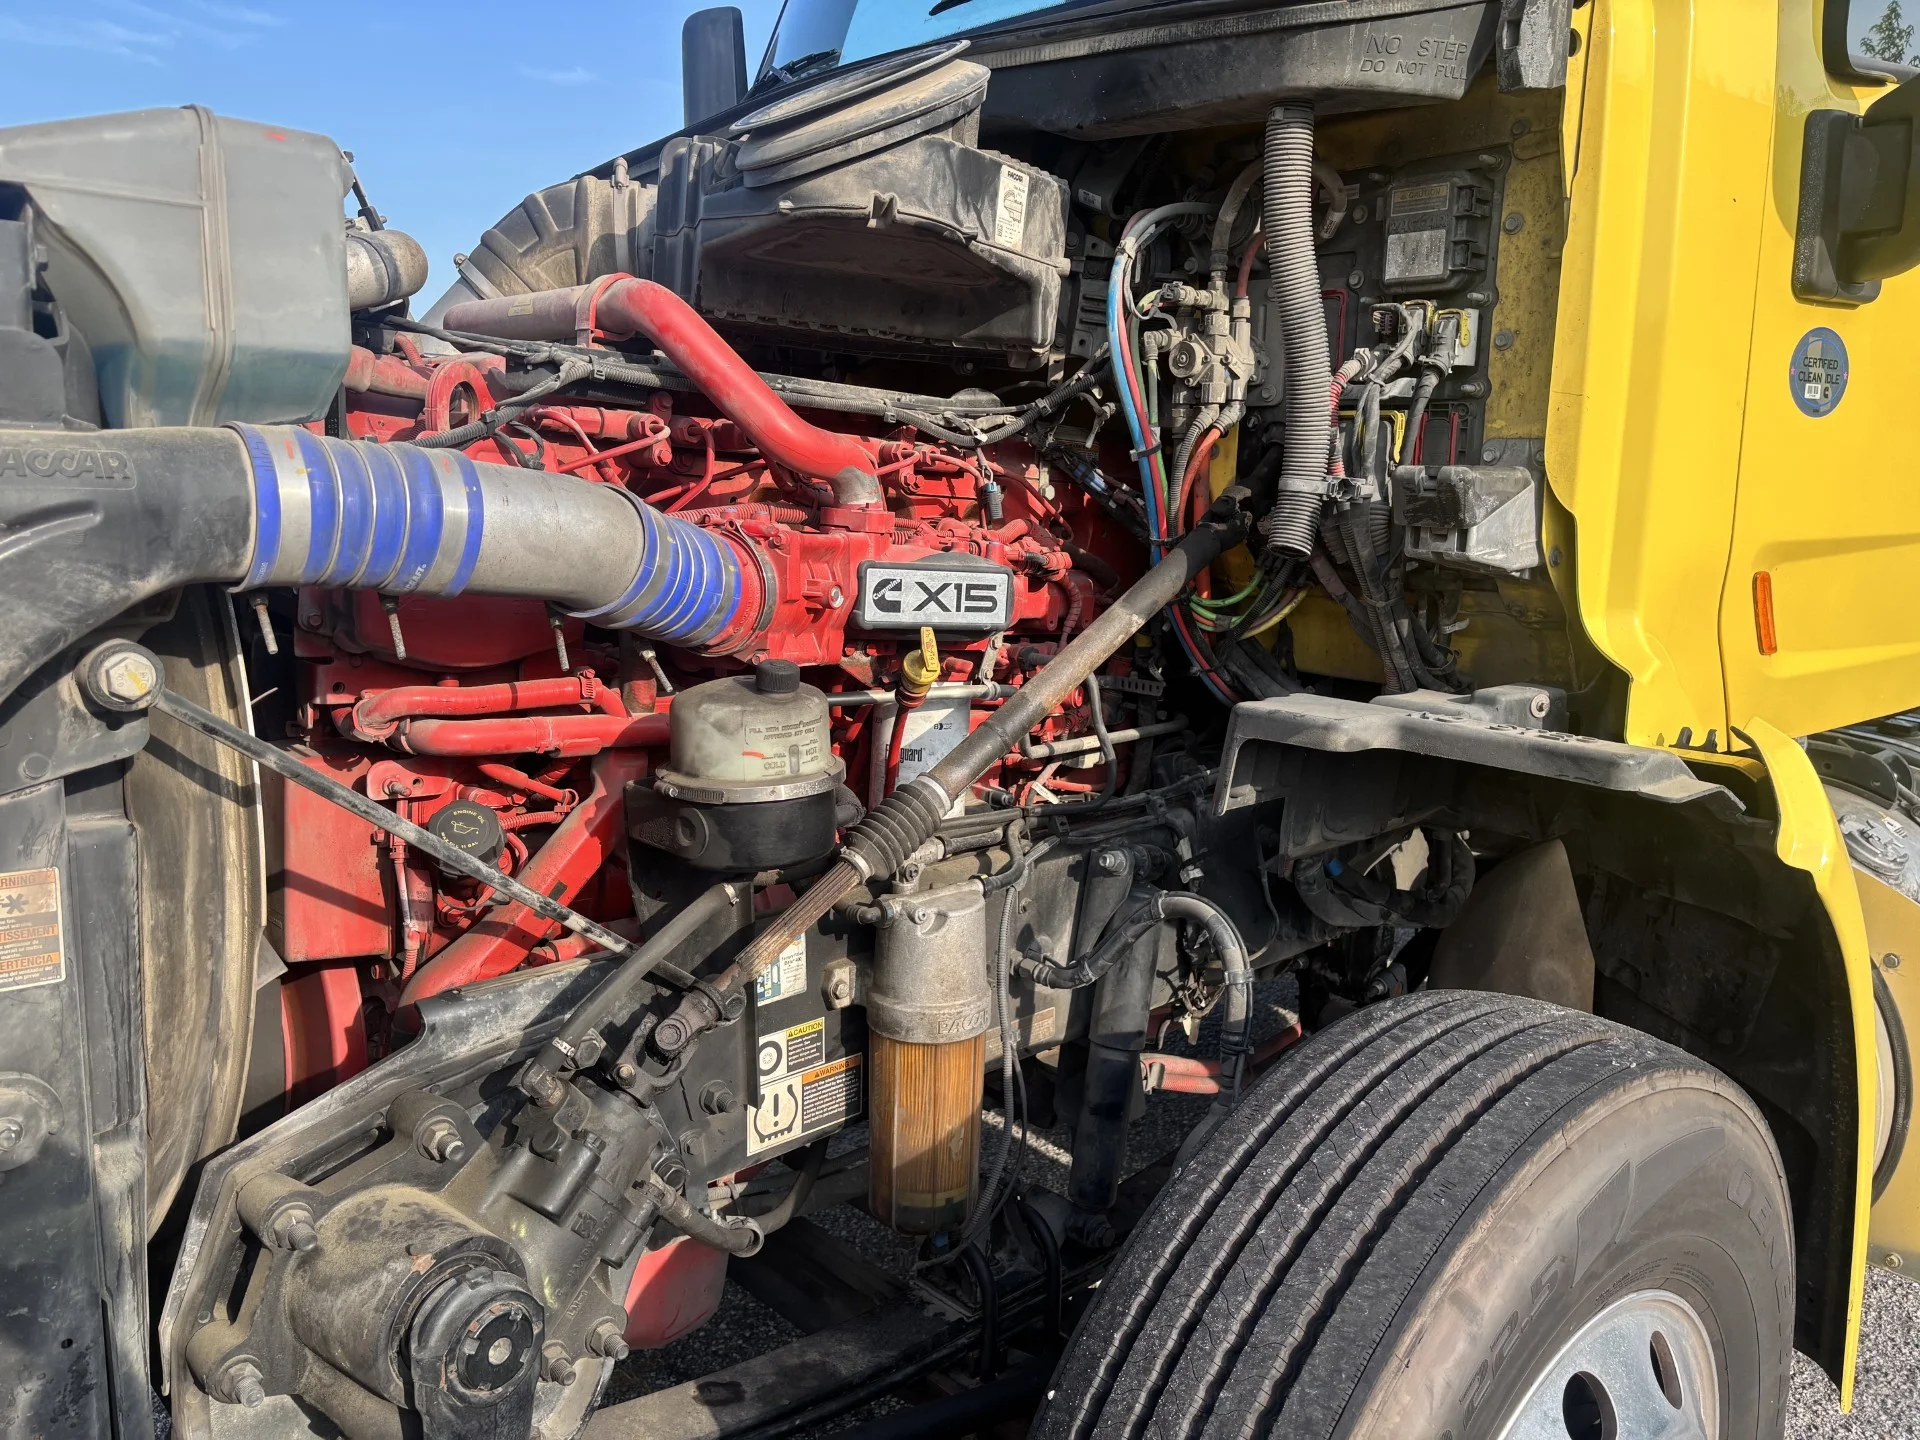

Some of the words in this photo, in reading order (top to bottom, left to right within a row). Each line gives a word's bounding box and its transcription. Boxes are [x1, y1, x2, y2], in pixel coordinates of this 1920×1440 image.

[1366, 33, 1402, 55] NO
[1416, 38, 1468, 61] STEP
[1360, 58, 1385, 73] DO
[1395, 61, 1427, 76] NOT
[1434, 65, 1467, 80] PULL
[1802, 356, 1839, 370] CERTIFIED
[1798, 371, 1822, 384] CLEAN
[1824, 374, 1841, 385] IDLE
[872, 578, 902, 601] Cummins
[912, 581, 998, 613] X15
[763, 760, 787, 770] COLD
[793, 1021, 823, 1036] CAUTION
[819, 1060, 850, 1076] WARNING
